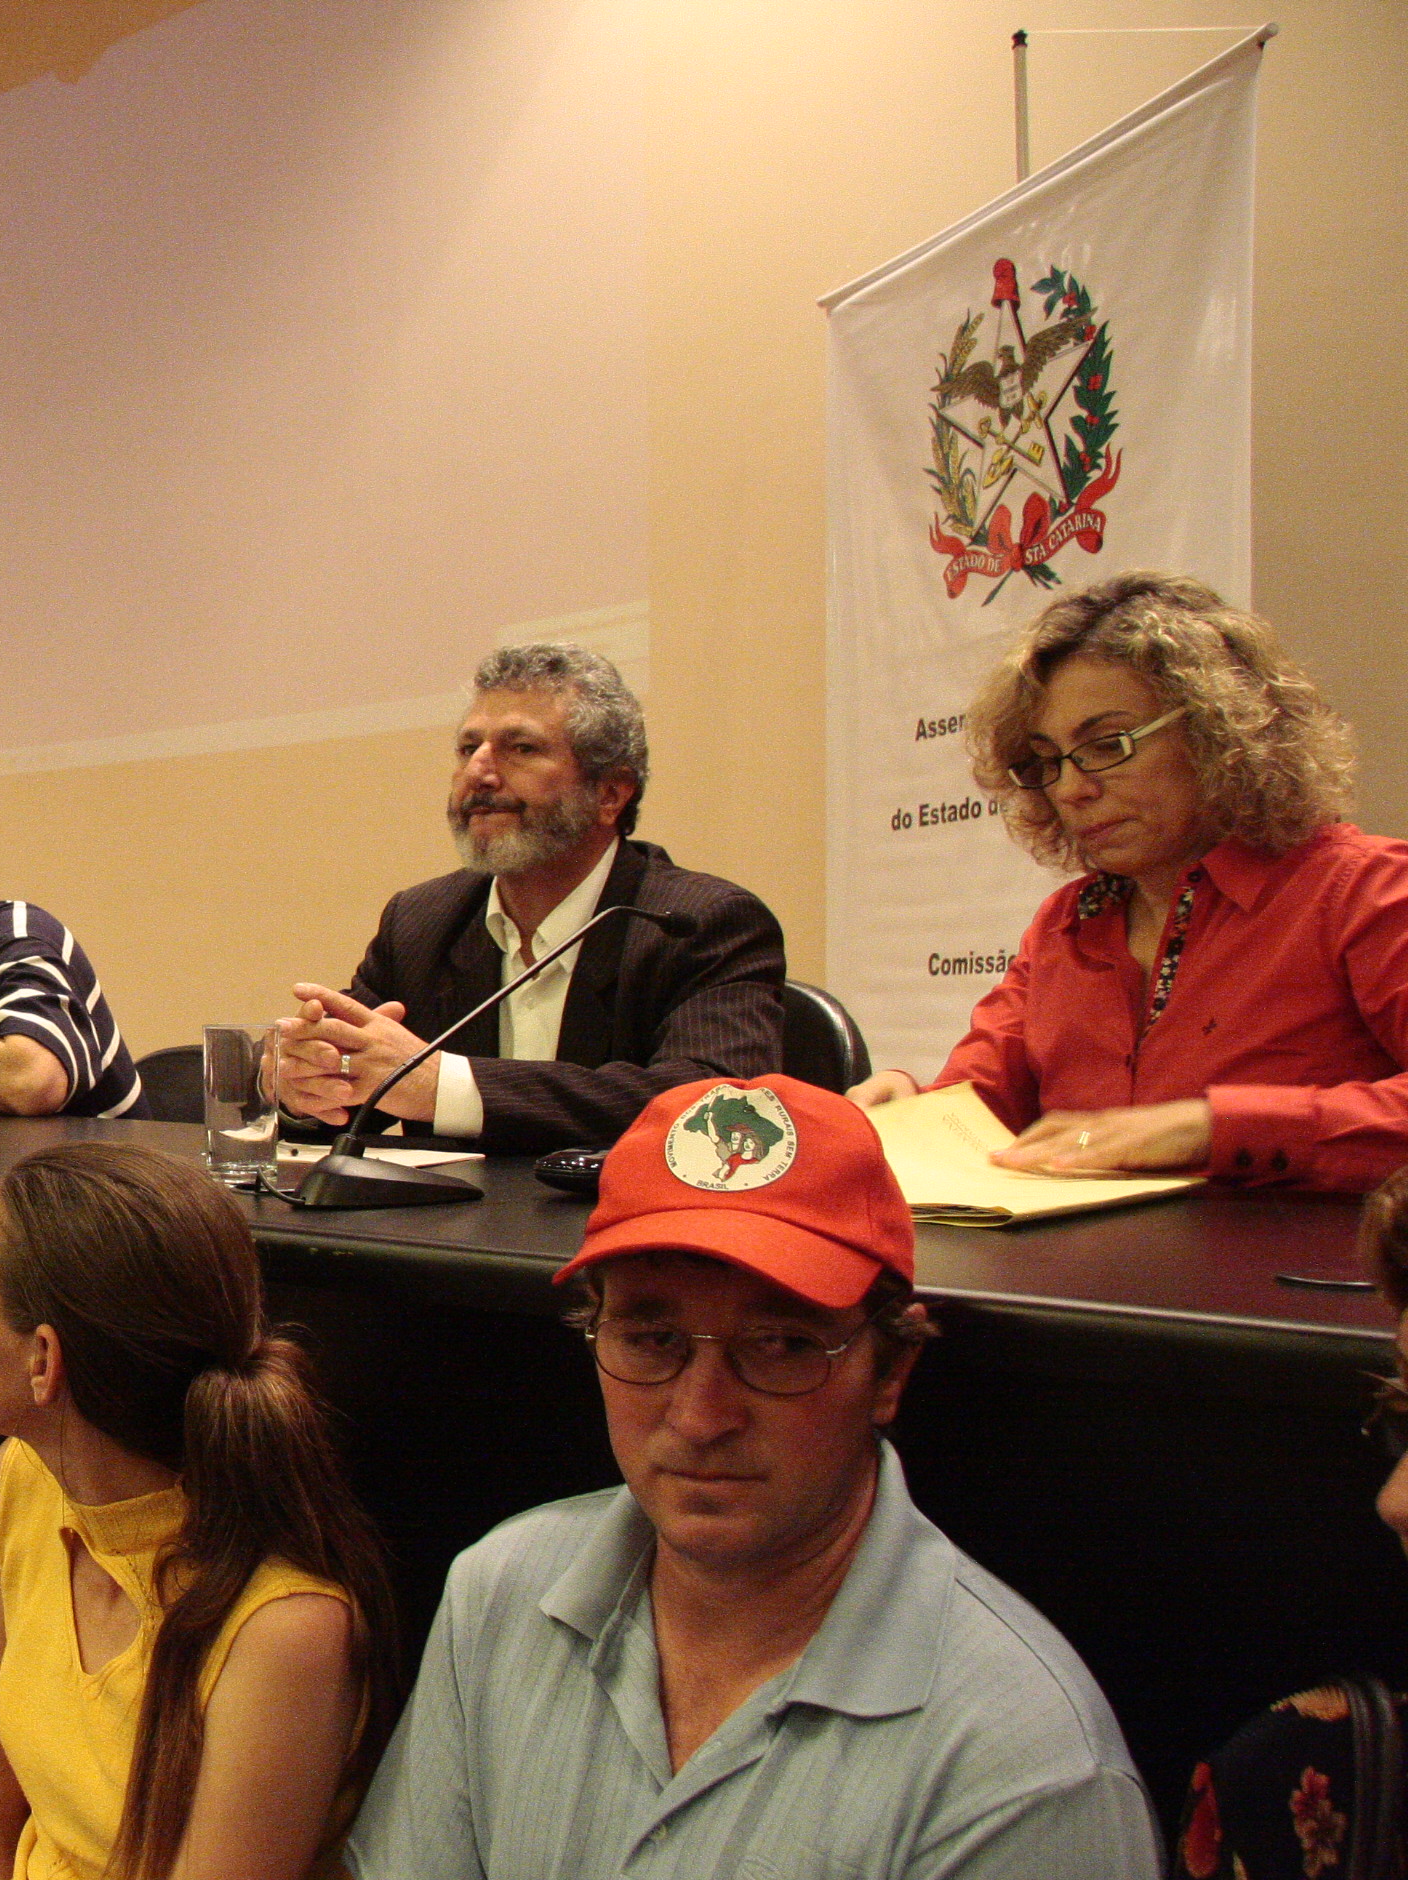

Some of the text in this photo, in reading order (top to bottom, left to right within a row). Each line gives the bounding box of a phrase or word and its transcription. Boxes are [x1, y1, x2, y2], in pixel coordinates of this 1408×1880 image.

[947, 556, 985, 582] ESTADO
[988, 557, 1002, 573] DE
[1048, 513, 1101, 550] CATARINA
[891, 808, 912, 831] do
[918, 796, 983, 828] Estado
[775, 1104, 795, 1140] RURAIS
[785, 1140, 794, 1160] SEM
[696, 1179, 730, 1191] BRASIL
[761, 1160, 789, 1182] TERRA
